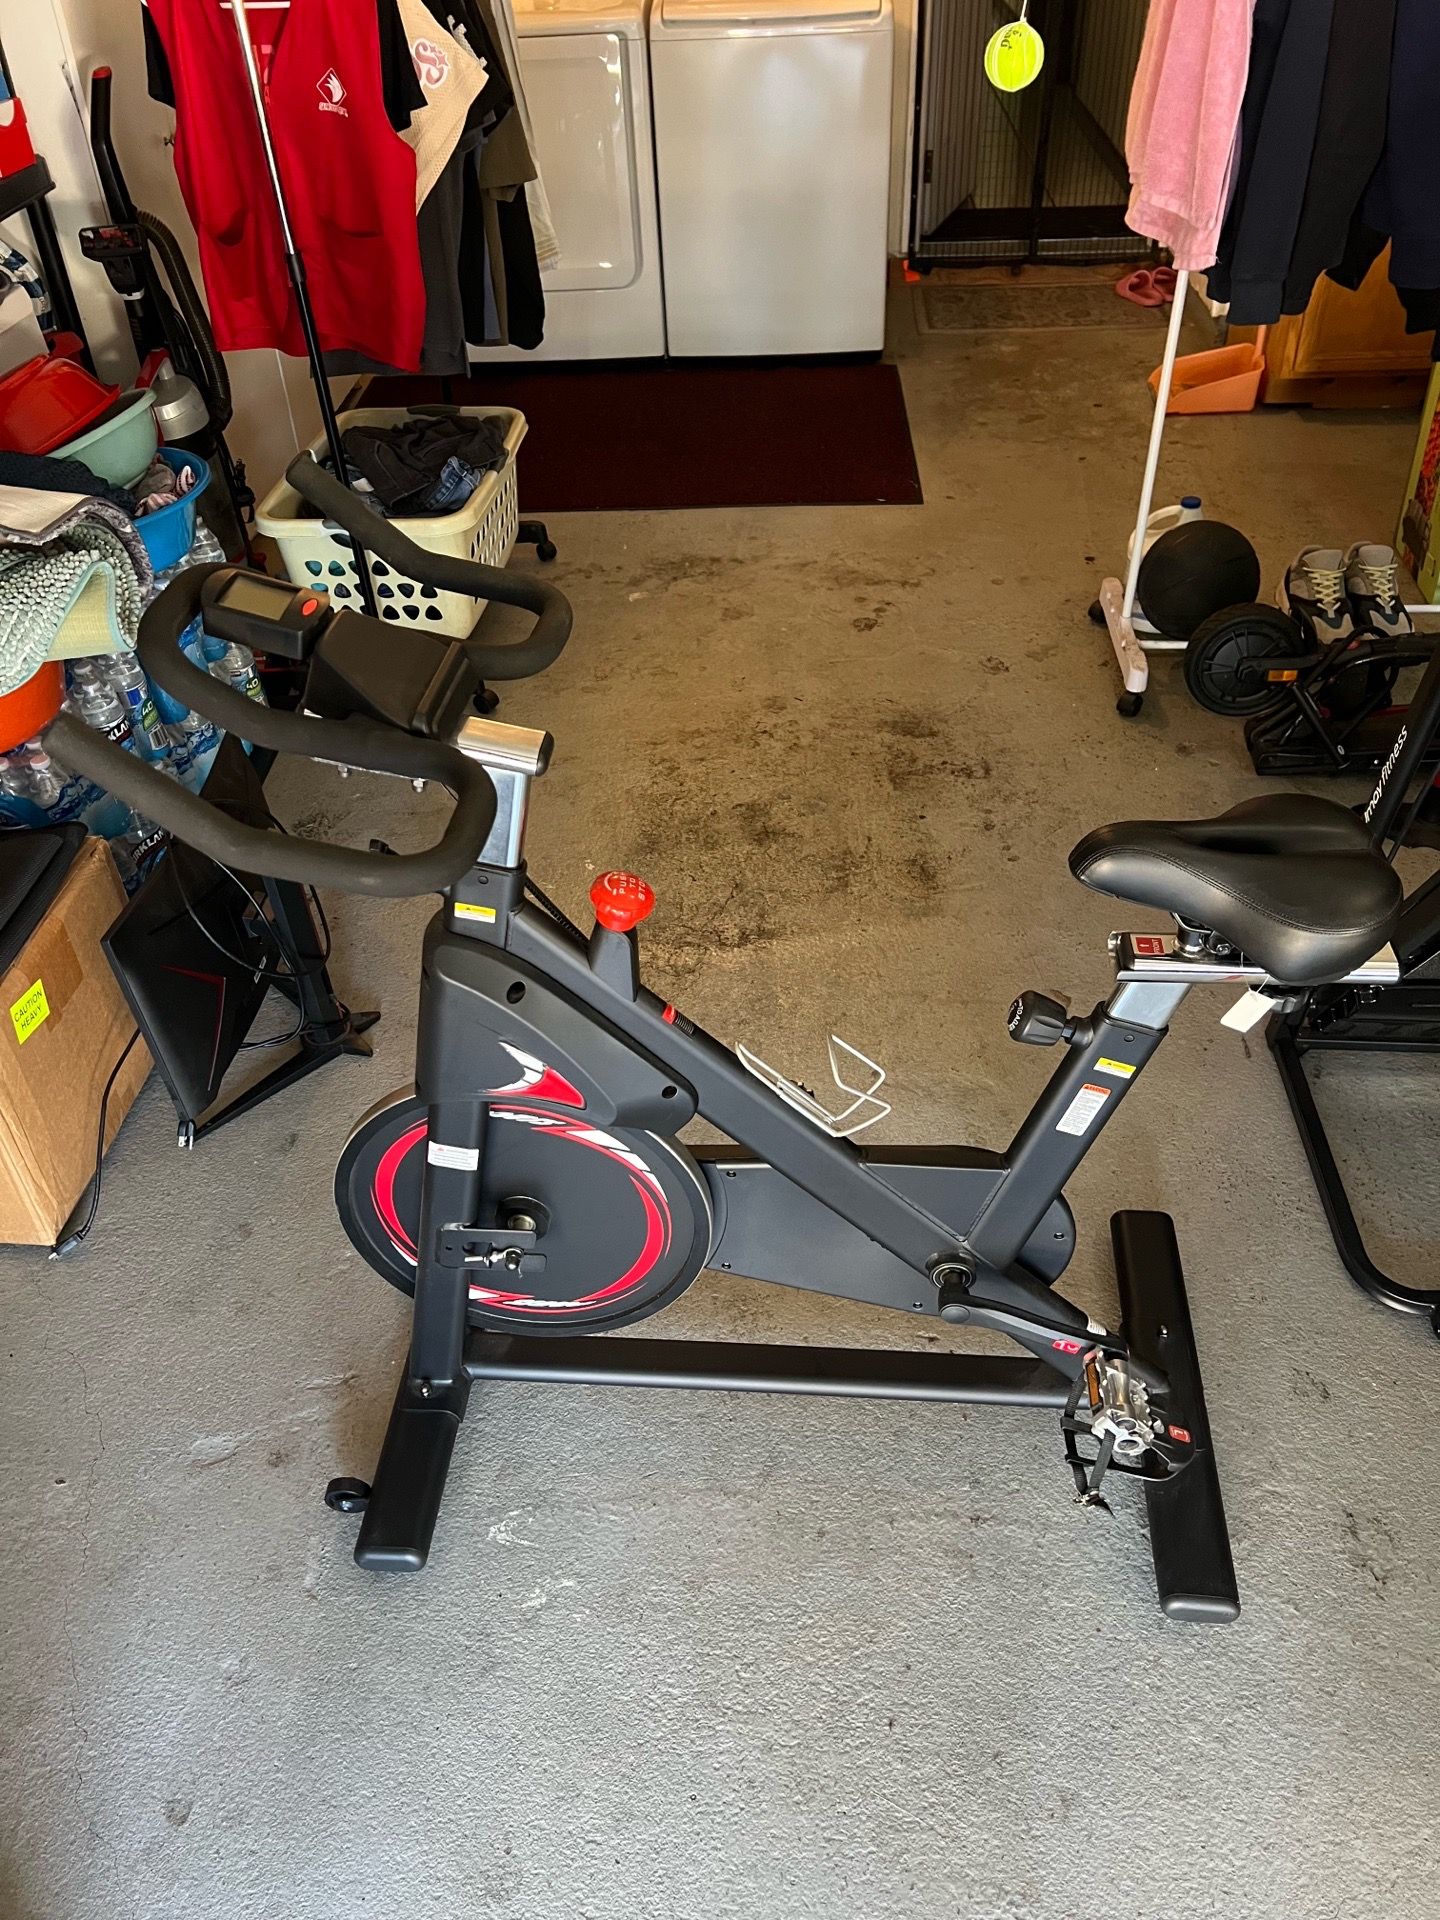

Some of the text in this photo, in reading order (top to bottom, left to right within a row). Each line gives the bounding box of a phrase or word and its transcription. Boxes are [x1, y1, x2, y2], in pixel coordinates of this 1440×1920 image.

[1381, 724, 1408, 786] fitness
[14, 990, 42, 1023] CAUTION
[21, 1005, 41, 1031] HEAVY
